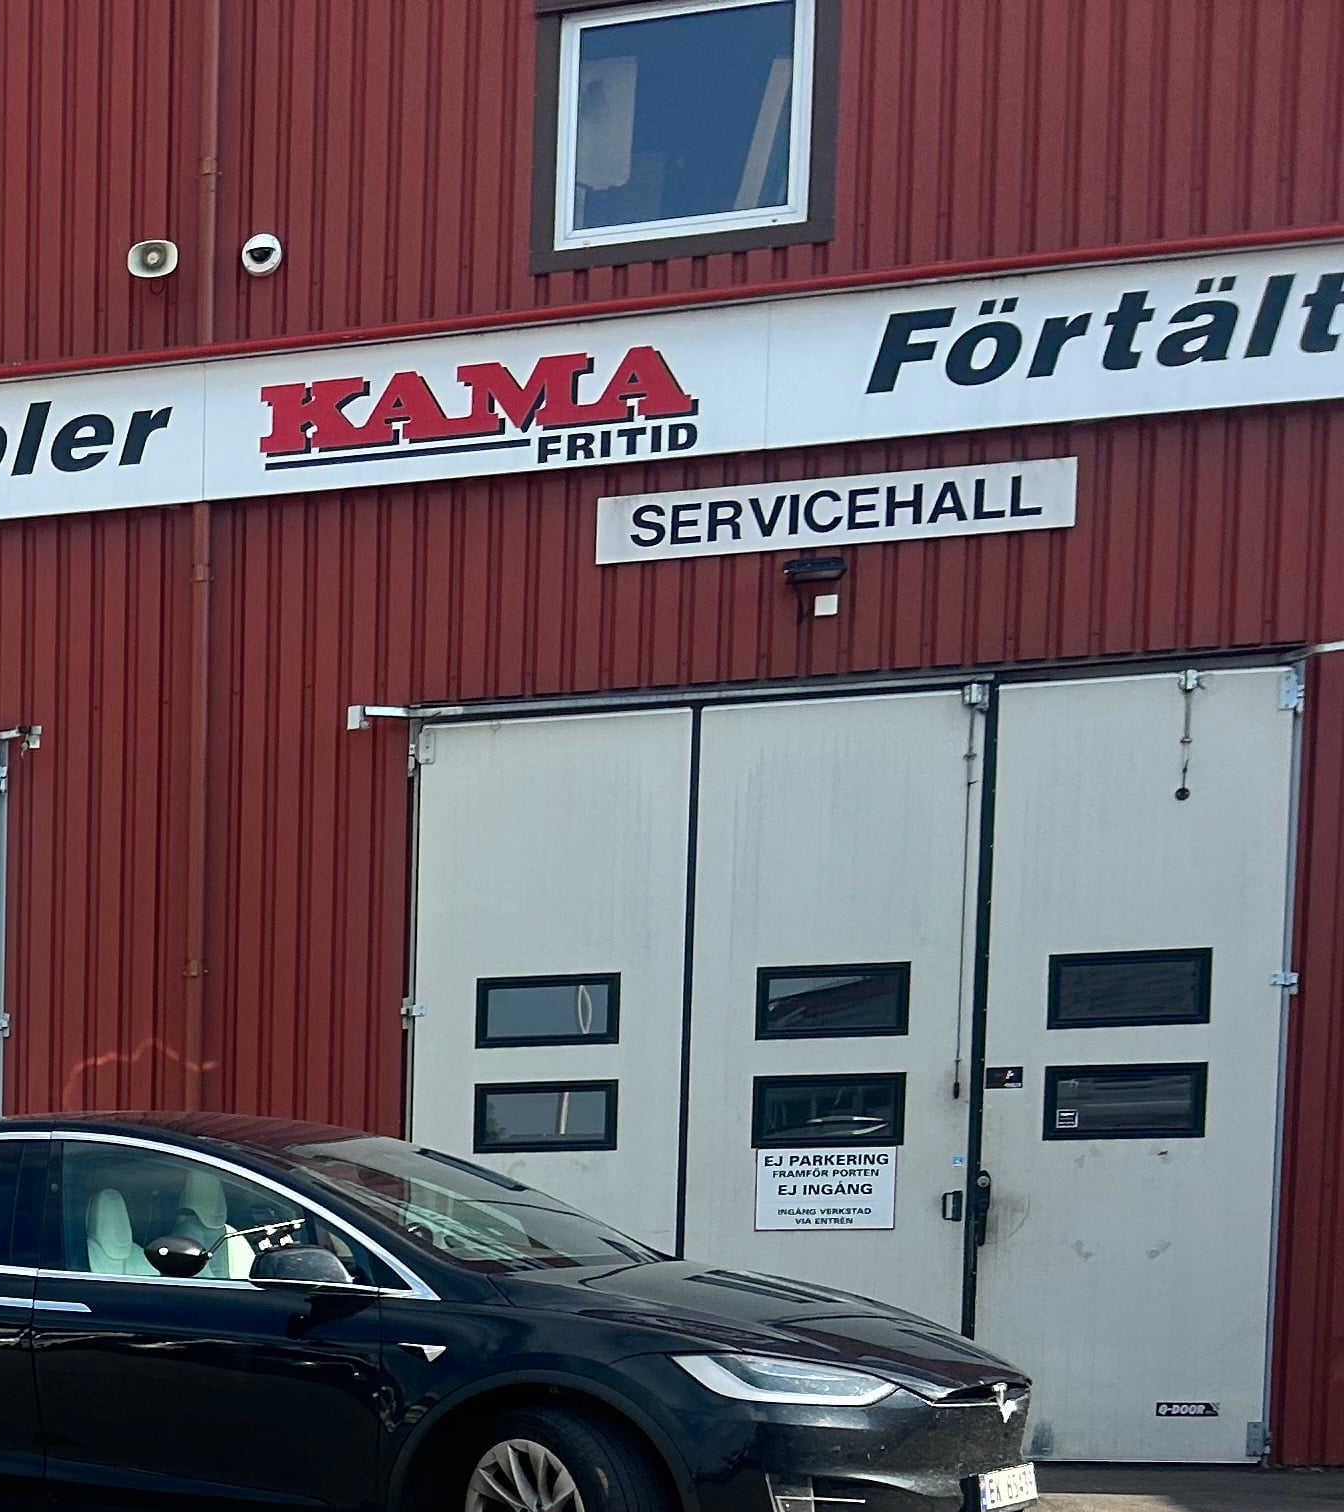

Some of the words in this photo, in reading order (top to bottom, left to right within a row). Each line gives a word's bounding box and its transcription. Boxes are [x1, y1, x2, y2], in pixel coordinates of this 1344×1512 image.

[865, 271, 1344, 395] Förtält
[258, 345, 699, 456] KAMA
[537, 423, 698, 464] FRITID
[630, 475, 1043, 548] SERVICEHALL
[764, 1156, 783, 1167] EJ
[789, 1153, 889, 1166] PARKERING
[772, 1168, 829, 1178] FRAMFÖR
[832, 1168, 879, 1177] PORTEN
[778, 1184, 797, 1196] EJ
[802, 1181, 873, 1196] INGÅNG
[778, 1207, 817, 1216] INGÅNG
[819, 1207, 872, 1215] VERKSTAD
